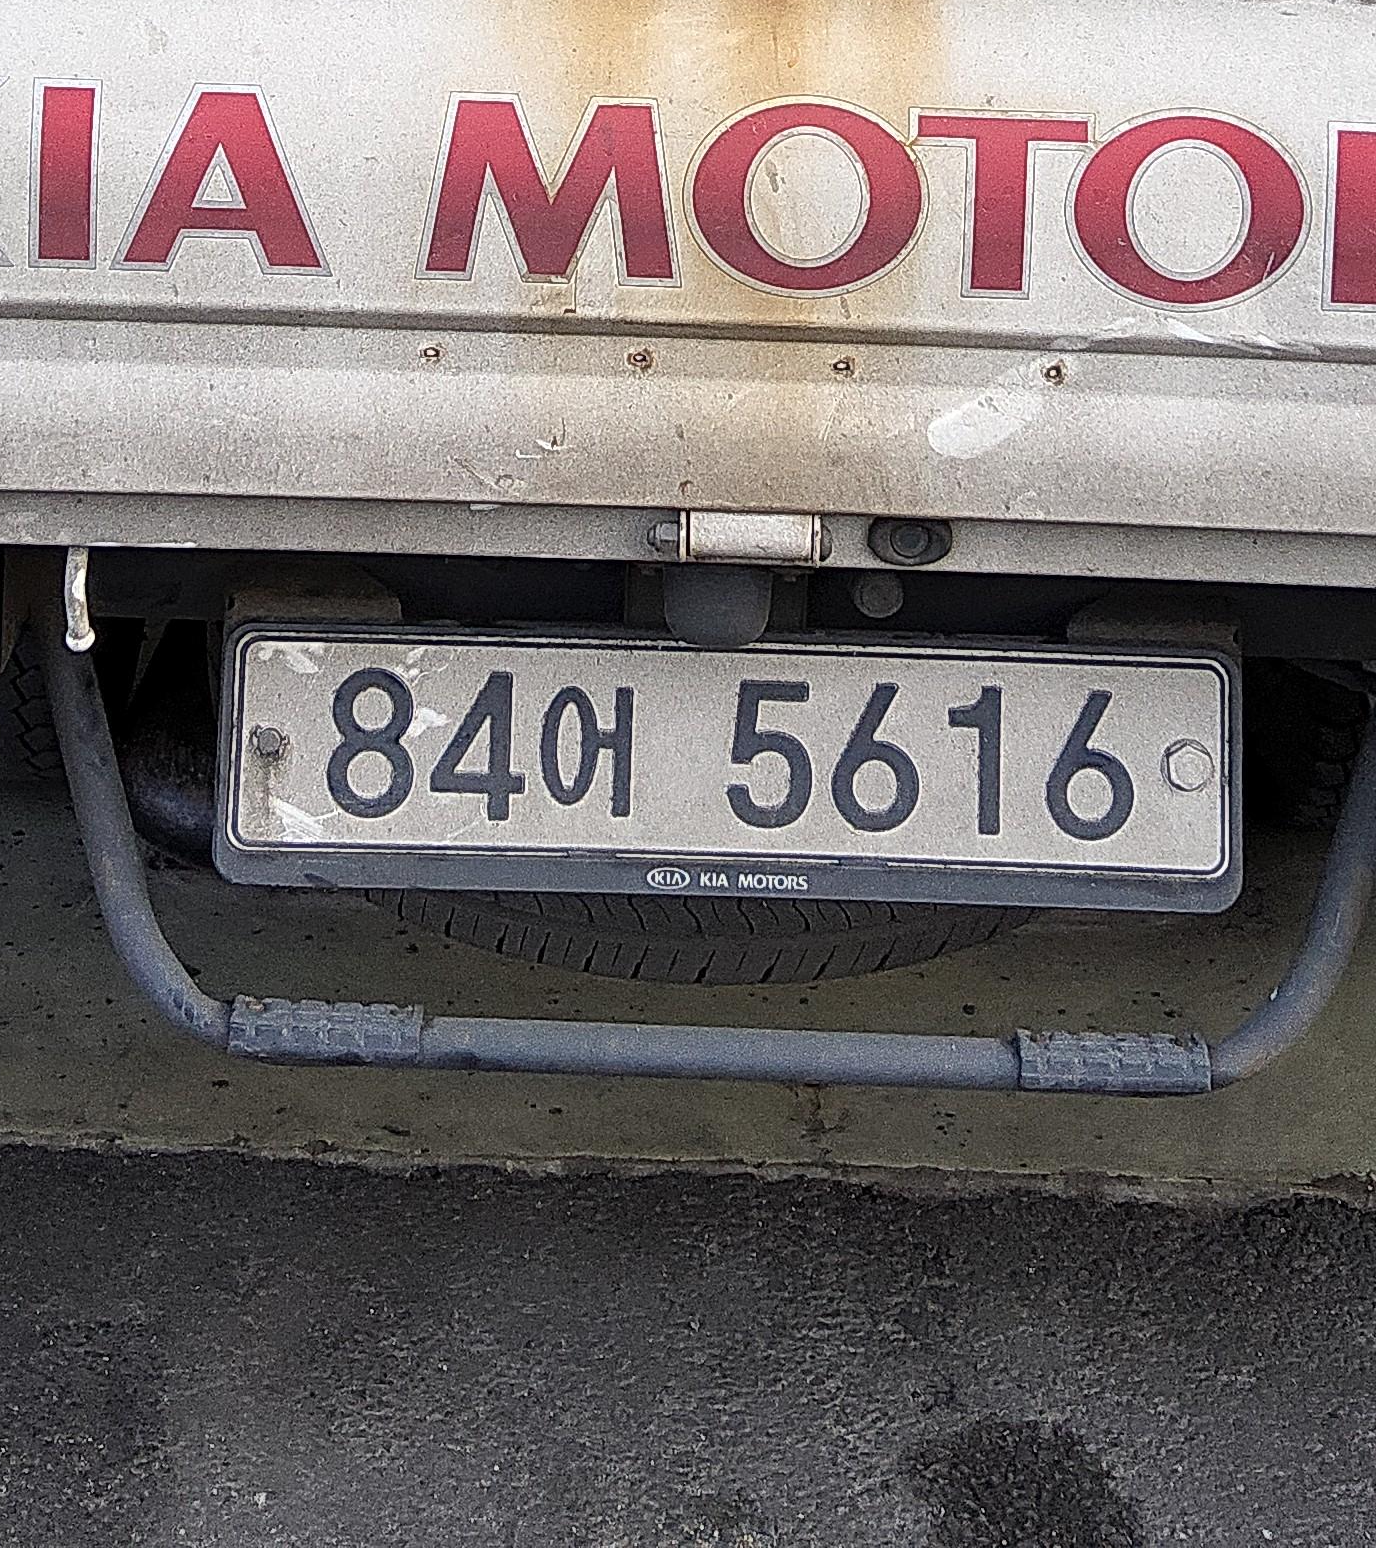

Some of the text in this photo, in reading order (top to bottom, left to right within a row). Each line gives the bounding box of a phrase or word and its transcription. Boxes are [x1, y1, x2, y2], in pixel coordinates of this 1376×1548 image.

[325, 666, 1135, 841] 84어 5616
[699, 871, 809, 891] KIA MOTORS
